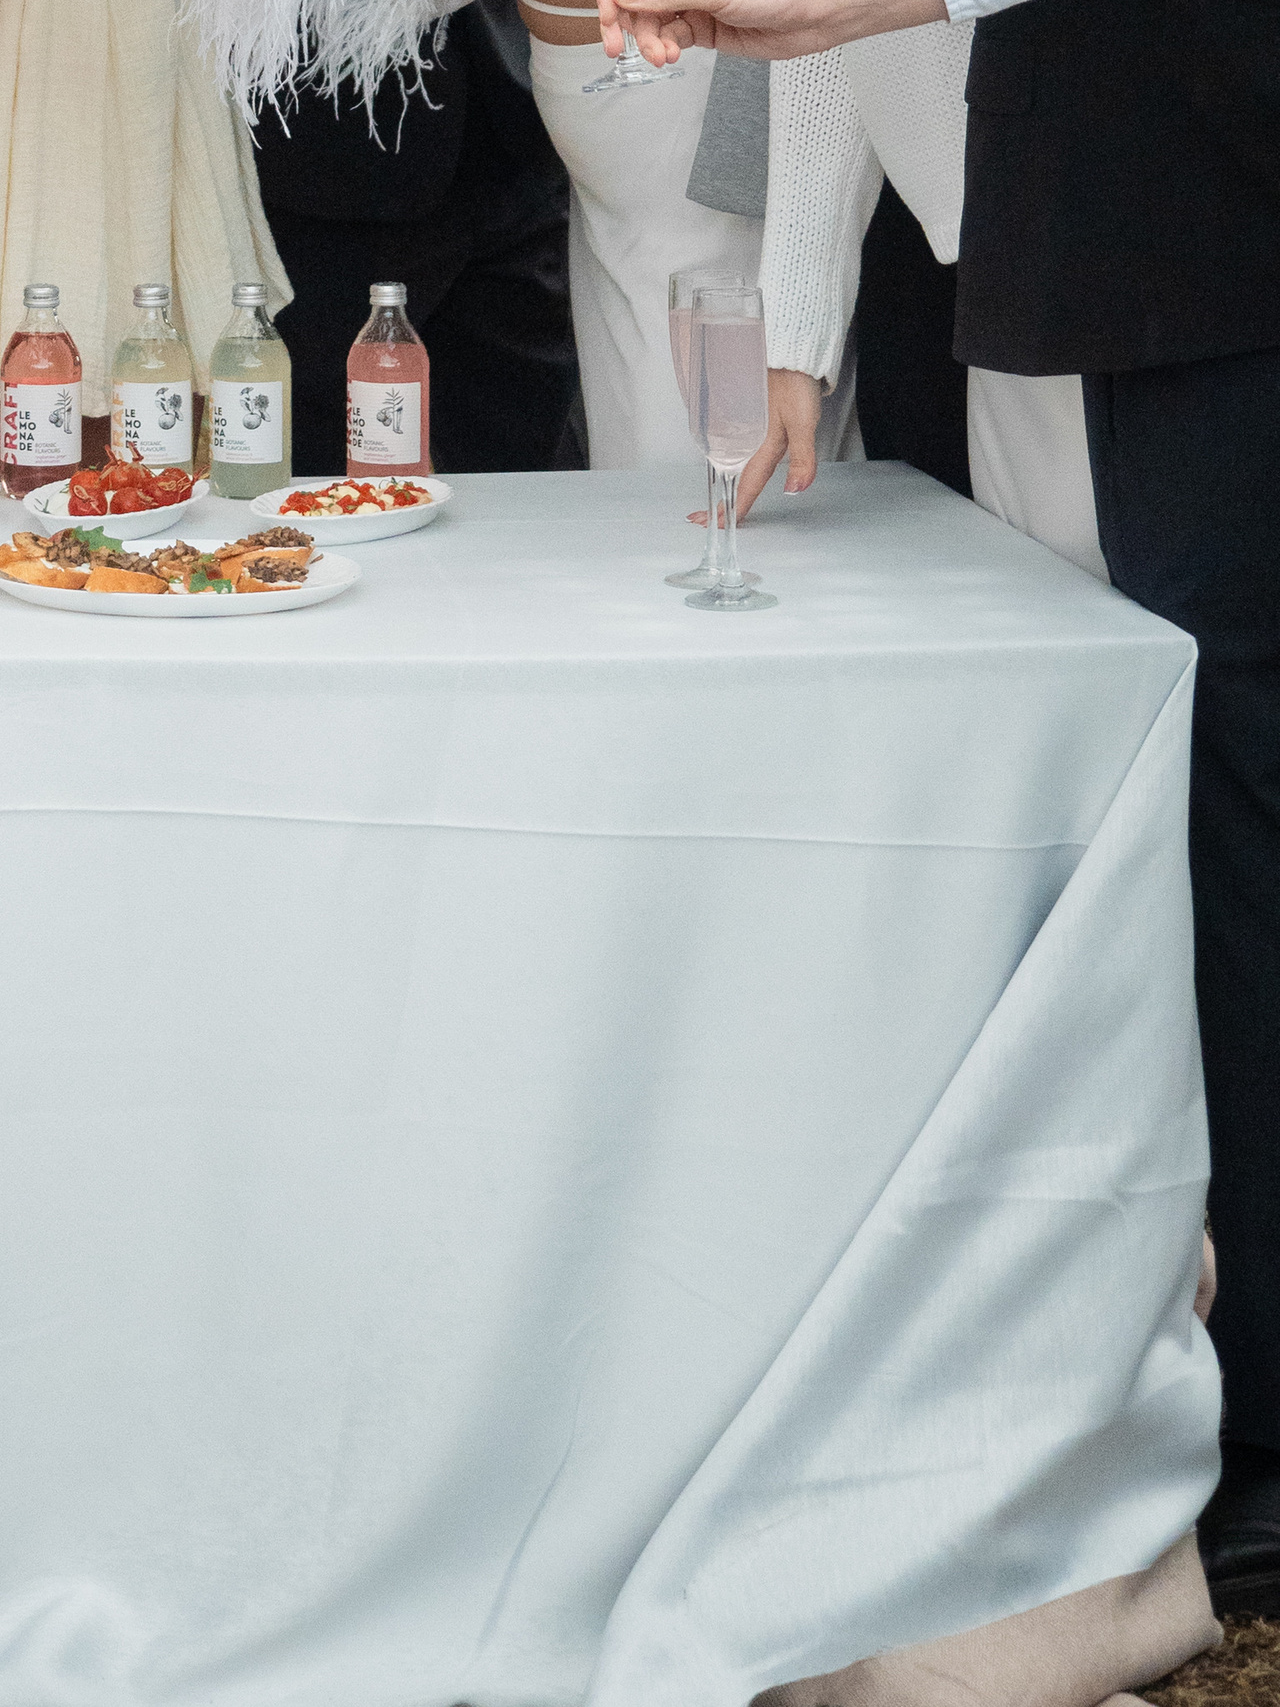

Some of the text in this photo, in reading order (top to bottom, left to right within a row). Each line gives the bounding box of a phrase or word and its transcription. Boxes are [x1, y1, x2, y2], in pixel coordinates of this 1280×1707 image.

[19, 411, 30, 420] LE
[125, 408, 136, 418] LE
[214, 406, 222, 416] LE
[352, 407, 360, 416] LE
[19, 422, 36, 431] MO
[125, 420, 141, 429] MO
[214, 418, 227, 427] MO
[353, 418, 366, 427] MO
[19, 432, 34, 441] NA
[125, 430, 140, 439] NA
[214, 428, 226, 437] NA
[352, 428, 364, 437] NA
[19, 442, 32, 451] DE
[214, 438, 224, 447] DE
[353, 438, 362, 448] DE
